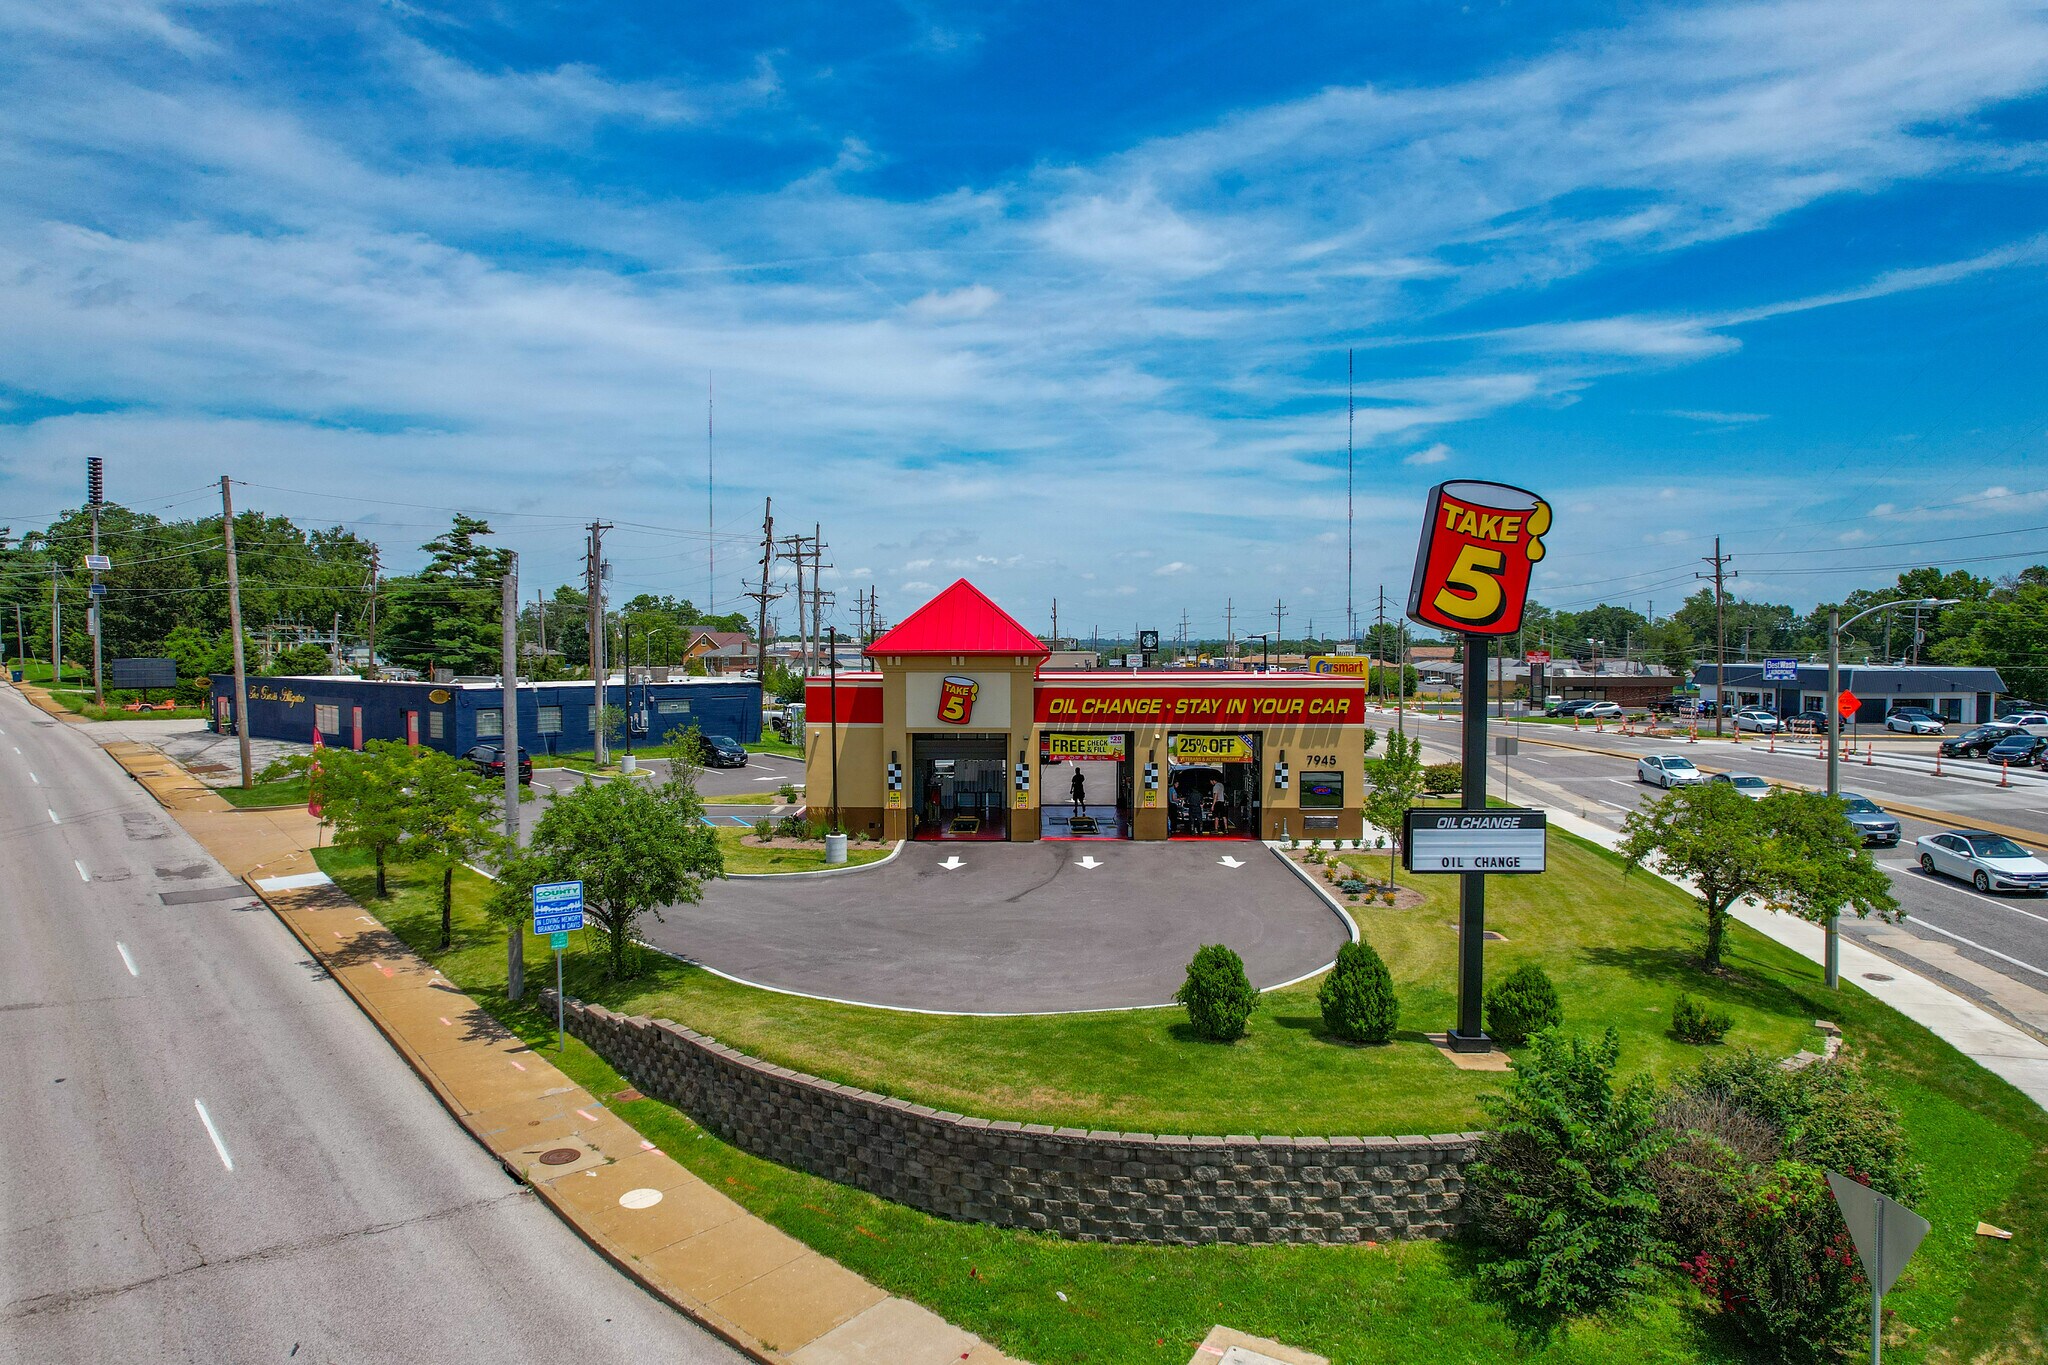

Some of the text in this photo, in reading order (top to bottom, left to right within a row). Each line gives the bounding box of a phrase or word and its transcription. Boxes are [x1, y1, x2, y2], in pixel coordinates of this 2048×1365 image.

[1442, 501, 1522, 543] TAKE
[1433, 543, 1504, 622] 5
[945, 683, 969, 696] TAKE
[942, 696, 964, 720] 5
[1050, 698, 1350, 714] OIL CHANGE STAY IN YOUR CAR
[1052, 740, 1086, 752] FREE
[1180, 738, 1234, 753] 25% OFF
[1307, 756, 1336, 766] 7945
[1436, 817, 1521, 828] OIL CHANGE
[1442, 857, 1520, 867] OIL CHANGE
[537, 888, 578, 897] COUNTY
